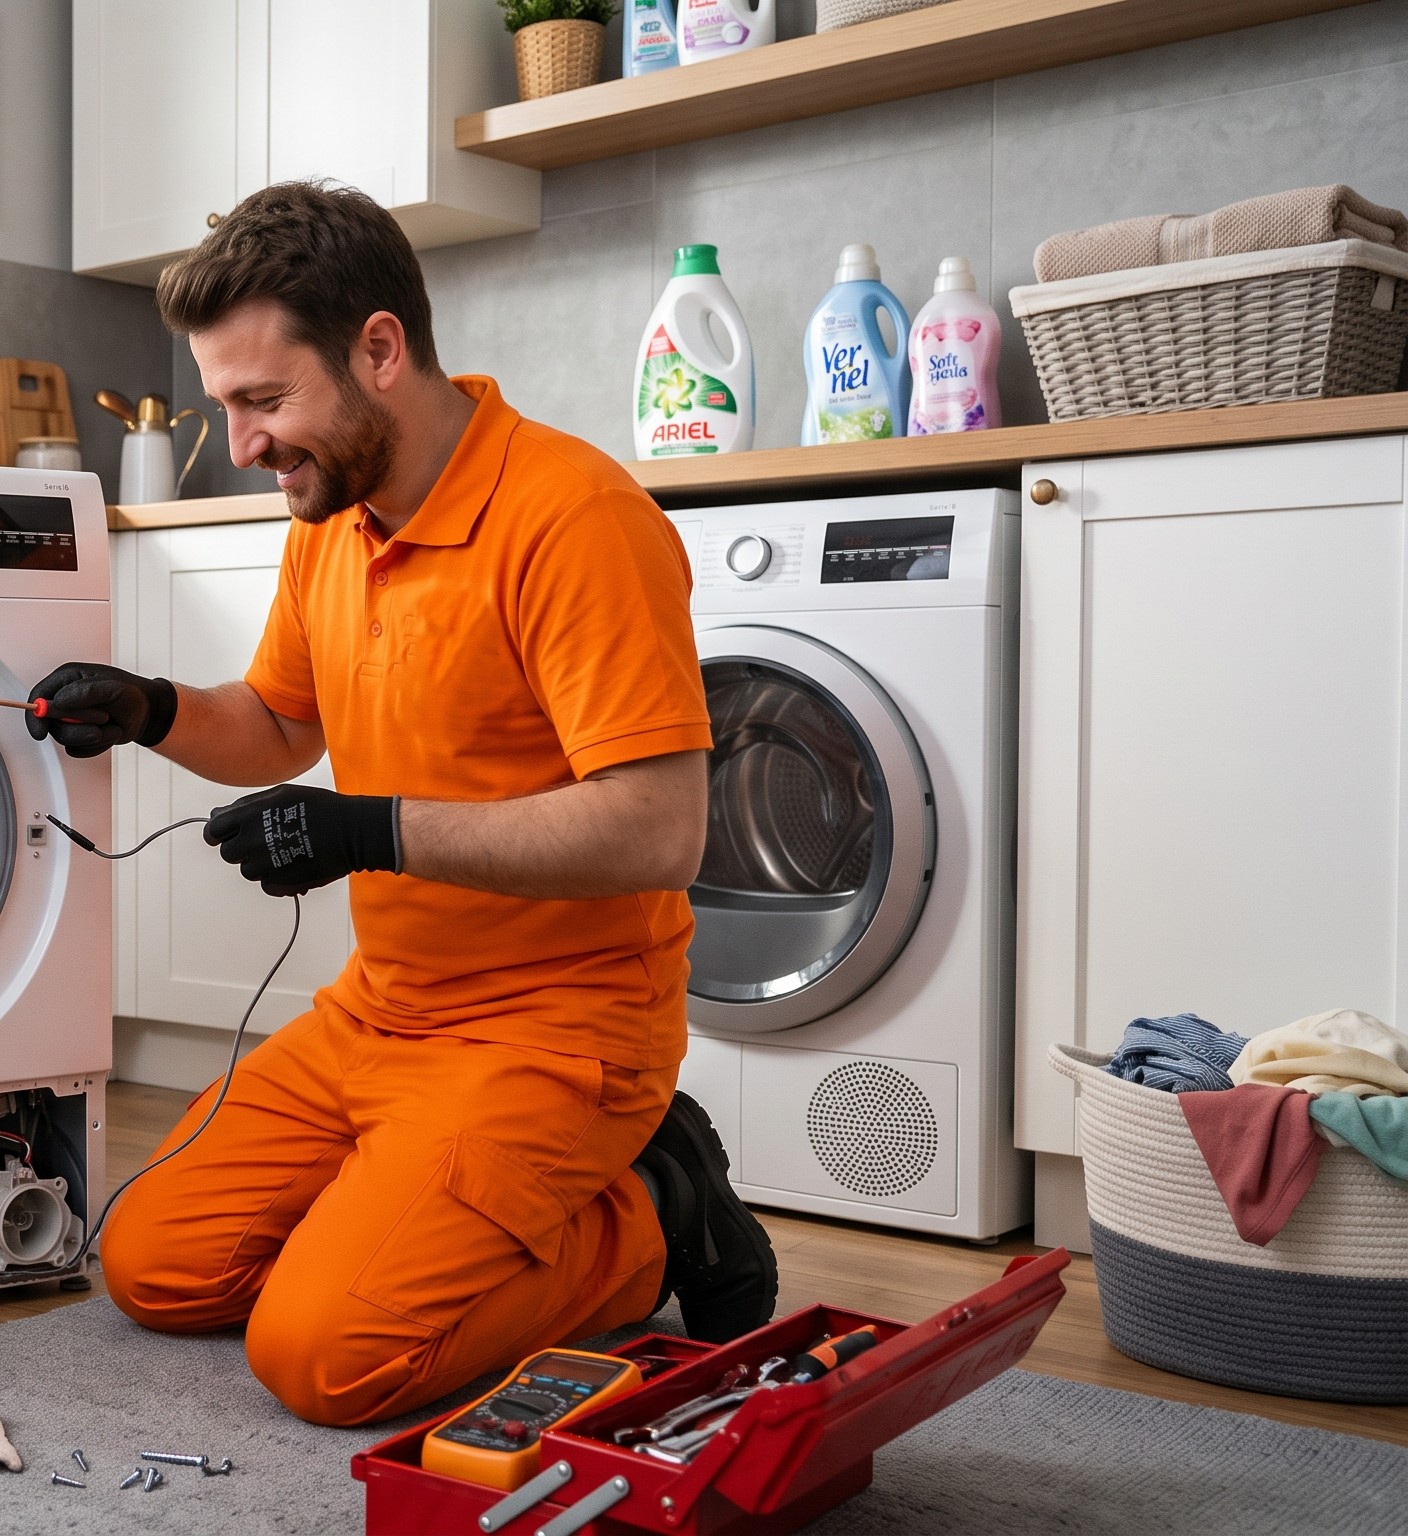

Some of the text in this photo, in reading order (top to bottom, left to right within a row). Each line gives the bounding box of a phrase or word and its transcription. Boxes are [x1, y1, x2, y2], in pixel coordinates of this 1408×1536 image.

[822, 342, 862, 374] Ver
[831, 359, 869, 394] nel
[652, 421, 716, 443] ARIEL
